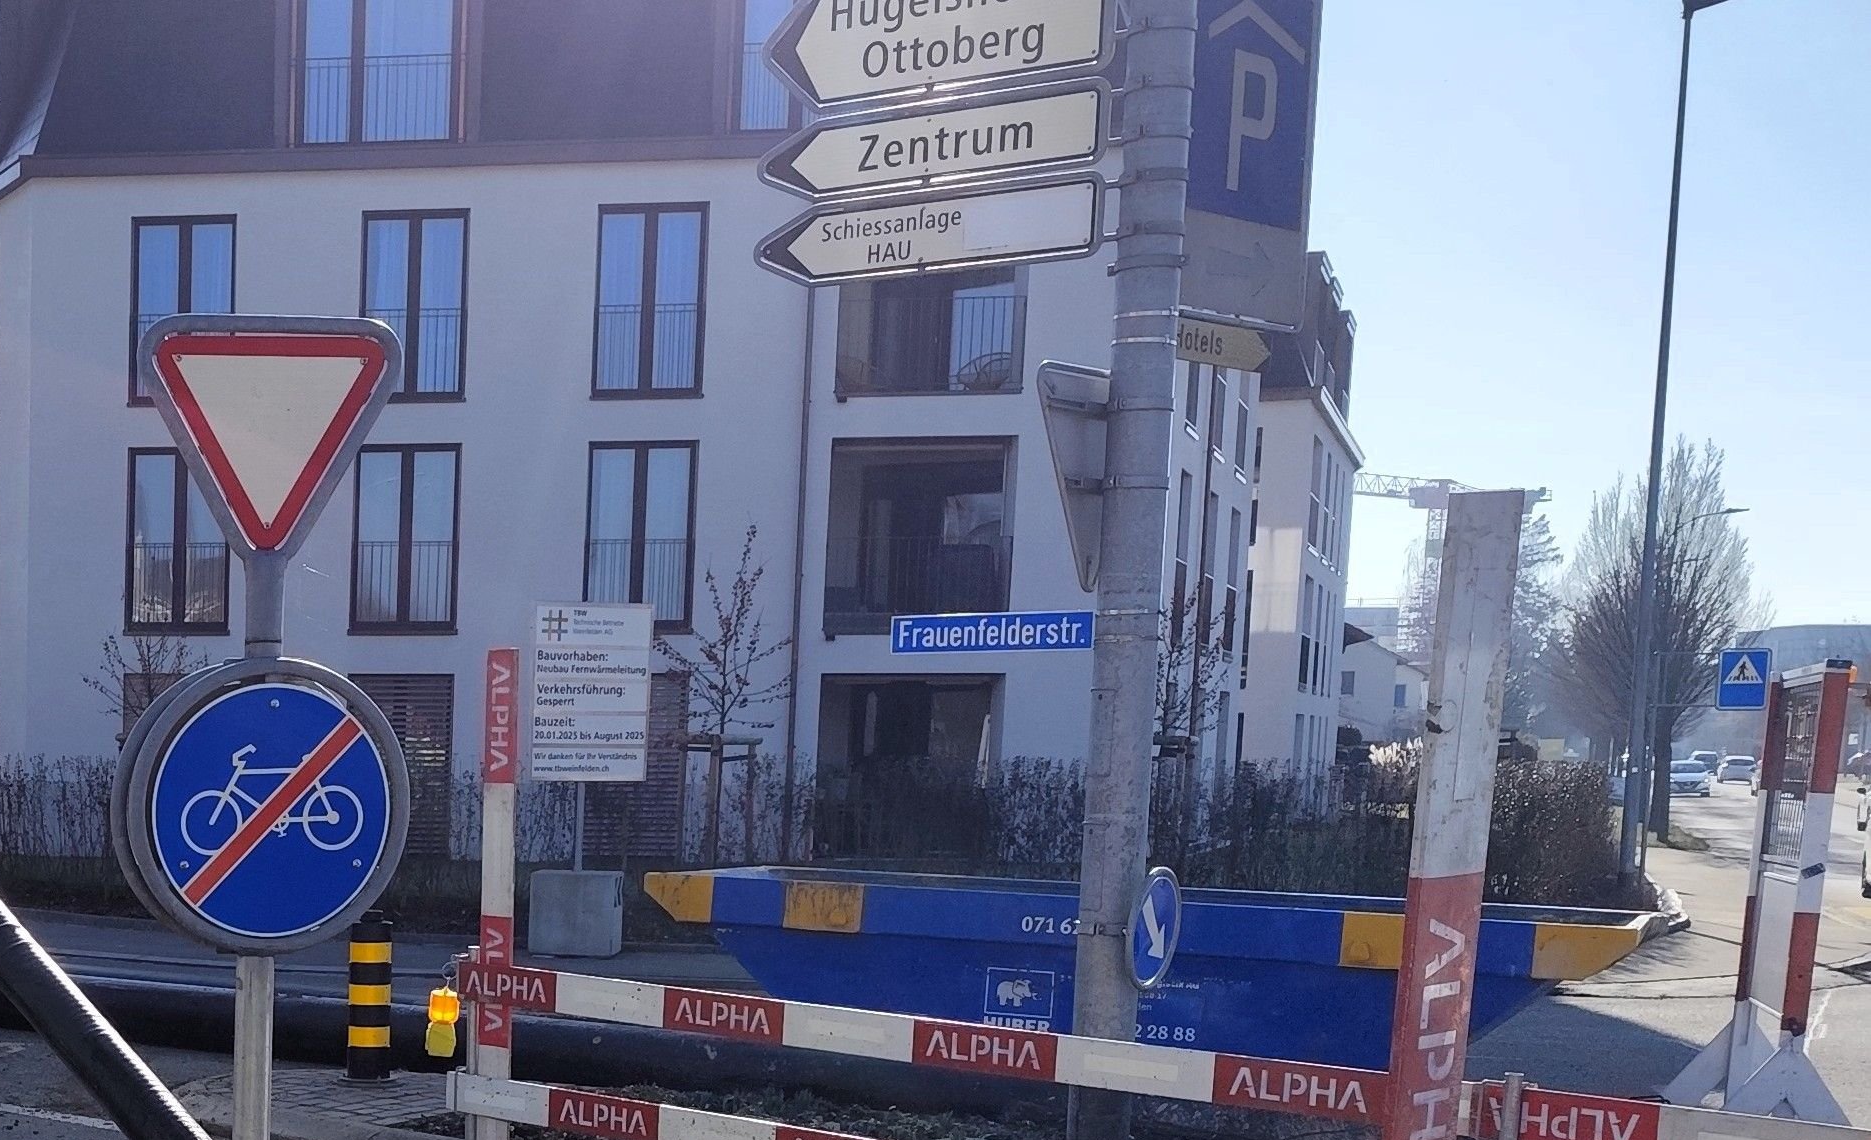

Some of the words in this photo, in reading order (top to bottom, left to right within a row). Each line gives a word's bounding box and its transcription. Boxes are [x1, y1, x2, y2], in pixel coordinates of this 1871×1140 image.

[862, 22, 1045, 78] Ottoberg
[857, 119, 1034, 173] Zentrum
[821, 206, 963, 243] Schiessanlage
[867, 240, 912, 265] HAU
[898, 616, 1086, 649] Frauenfelderstr.
[536, 664, 569, 673] Neubau
[570, 664, 647, 677] Fernwärmeleitung
[537, 650, 609, 662] Bauvorhaben:
[536, 696, 575, 707] Gesperrt
[537, 683, 626, 698] Verkehrsführung:
[489, 662, 511, 773] ALPHA
[534, 716, 576, 727] Bauzeit:
[534, 730, 578, 740] 20.01.2025
[579, 731, 592, 740] bis
[593, 731, 623, 742] August
[624, 731, 645, 740] 2025
[547, 752, 574, 761] danken
[1021, 916, 1054, 934] 071
[465, 970, 547, 1004] ALPHA
[674, 997, 771, 1036] ALPHA
[925, 1029, 1041, 1071] ALPHA
[1229, 1066, 1368, 1114] ALPHA
[559, 1098, 647, 1137] ALPHA
